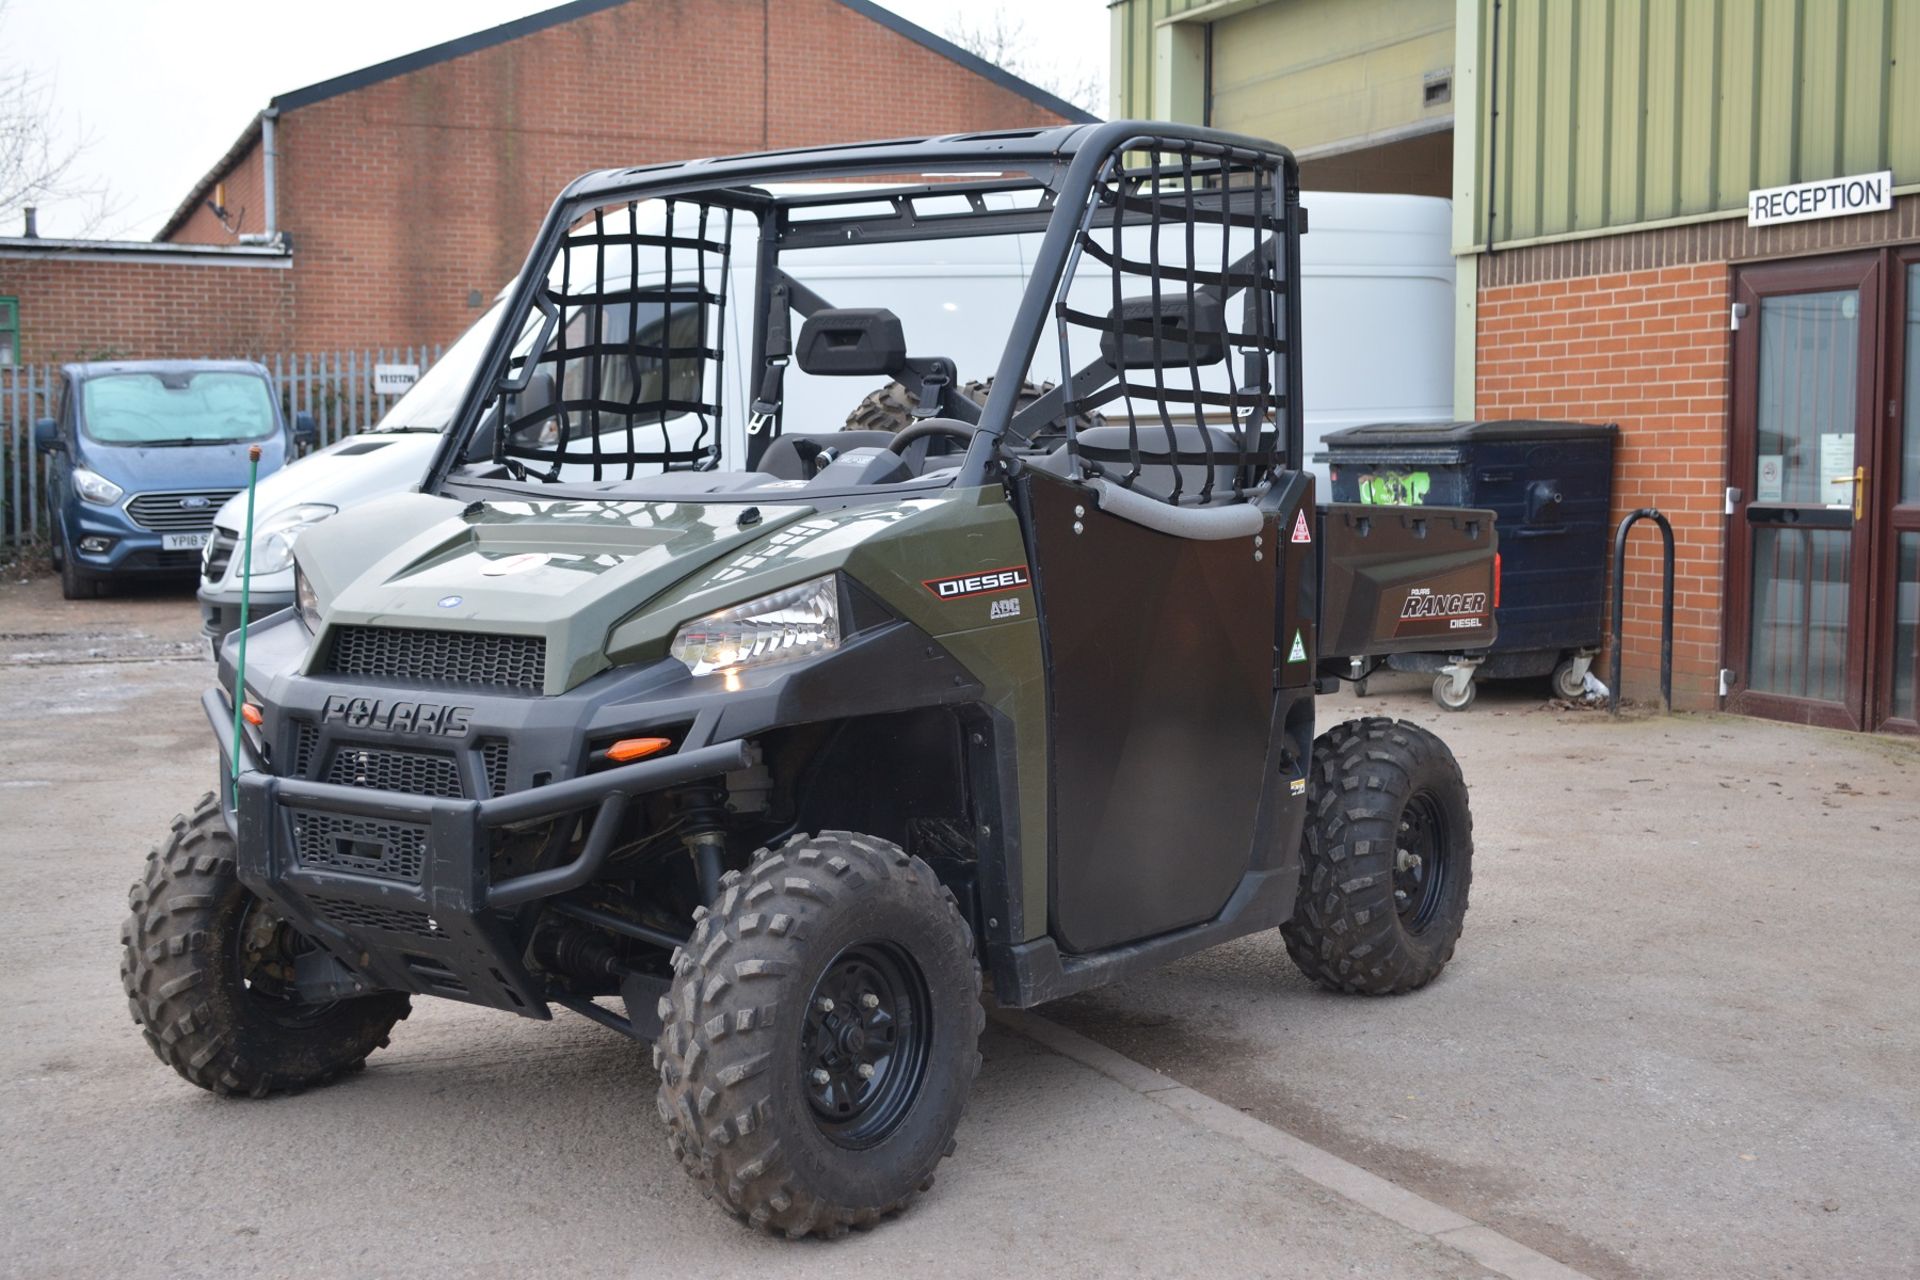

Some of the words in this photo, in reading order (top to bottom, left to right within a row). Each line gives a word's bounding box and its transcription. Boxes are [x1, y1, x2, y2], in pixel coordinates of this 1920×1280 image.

[1755, 178, 1882, 219] RECEPTION
[939, 571, 1027, 596] DIESEL
[1400, 592, 1486, 618] RANGER
[1449, 618, 1483, 629] DIESEL
[322, 694, 475, 738] POLARIS
